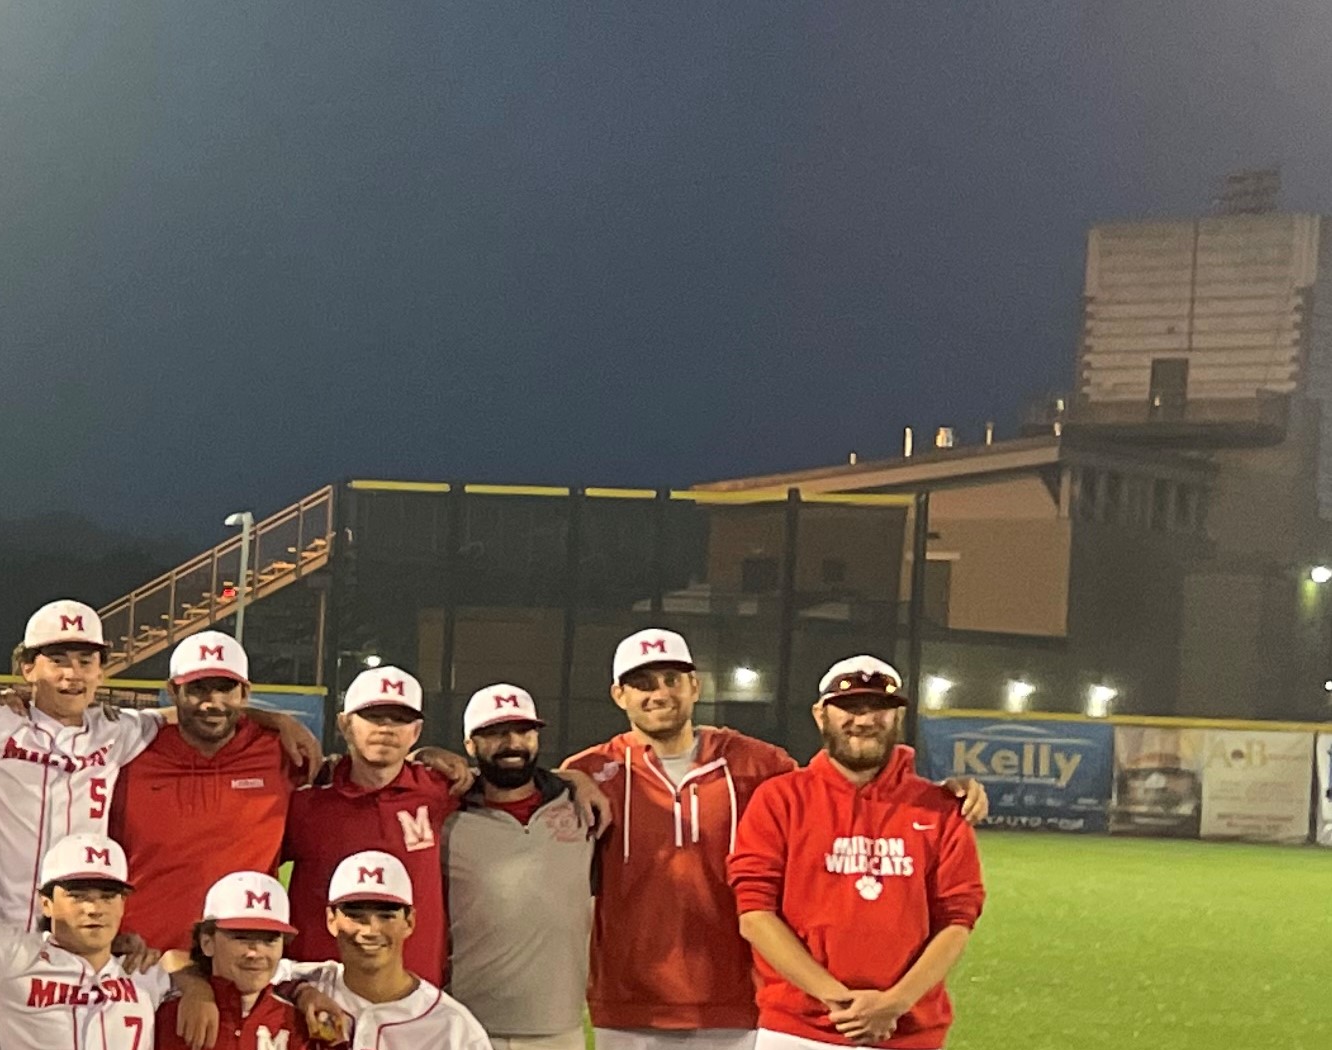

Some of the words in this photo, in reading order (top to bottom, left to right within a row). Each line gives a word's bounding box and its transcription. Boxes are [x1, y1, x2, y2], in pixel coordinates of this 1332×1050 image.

[60, 615, 84, 631] M
[200, 645, 225, 661] M
[639, 639, 667, 655] M
[380, 678, 405, 696] M
[493, 694, 520, 708] M
[952, 739, 1083, 789] Kelly
[89, 777, 107, 819] 5
[397, 805, 436, 853] M
[84, 846, 112, 867] M
[833, 835, 905, 857] MILTON
[356, 866, 385, 884] M
[823, 852, 914, 877] WILDCATS
[244, 890, 272, 911] M
